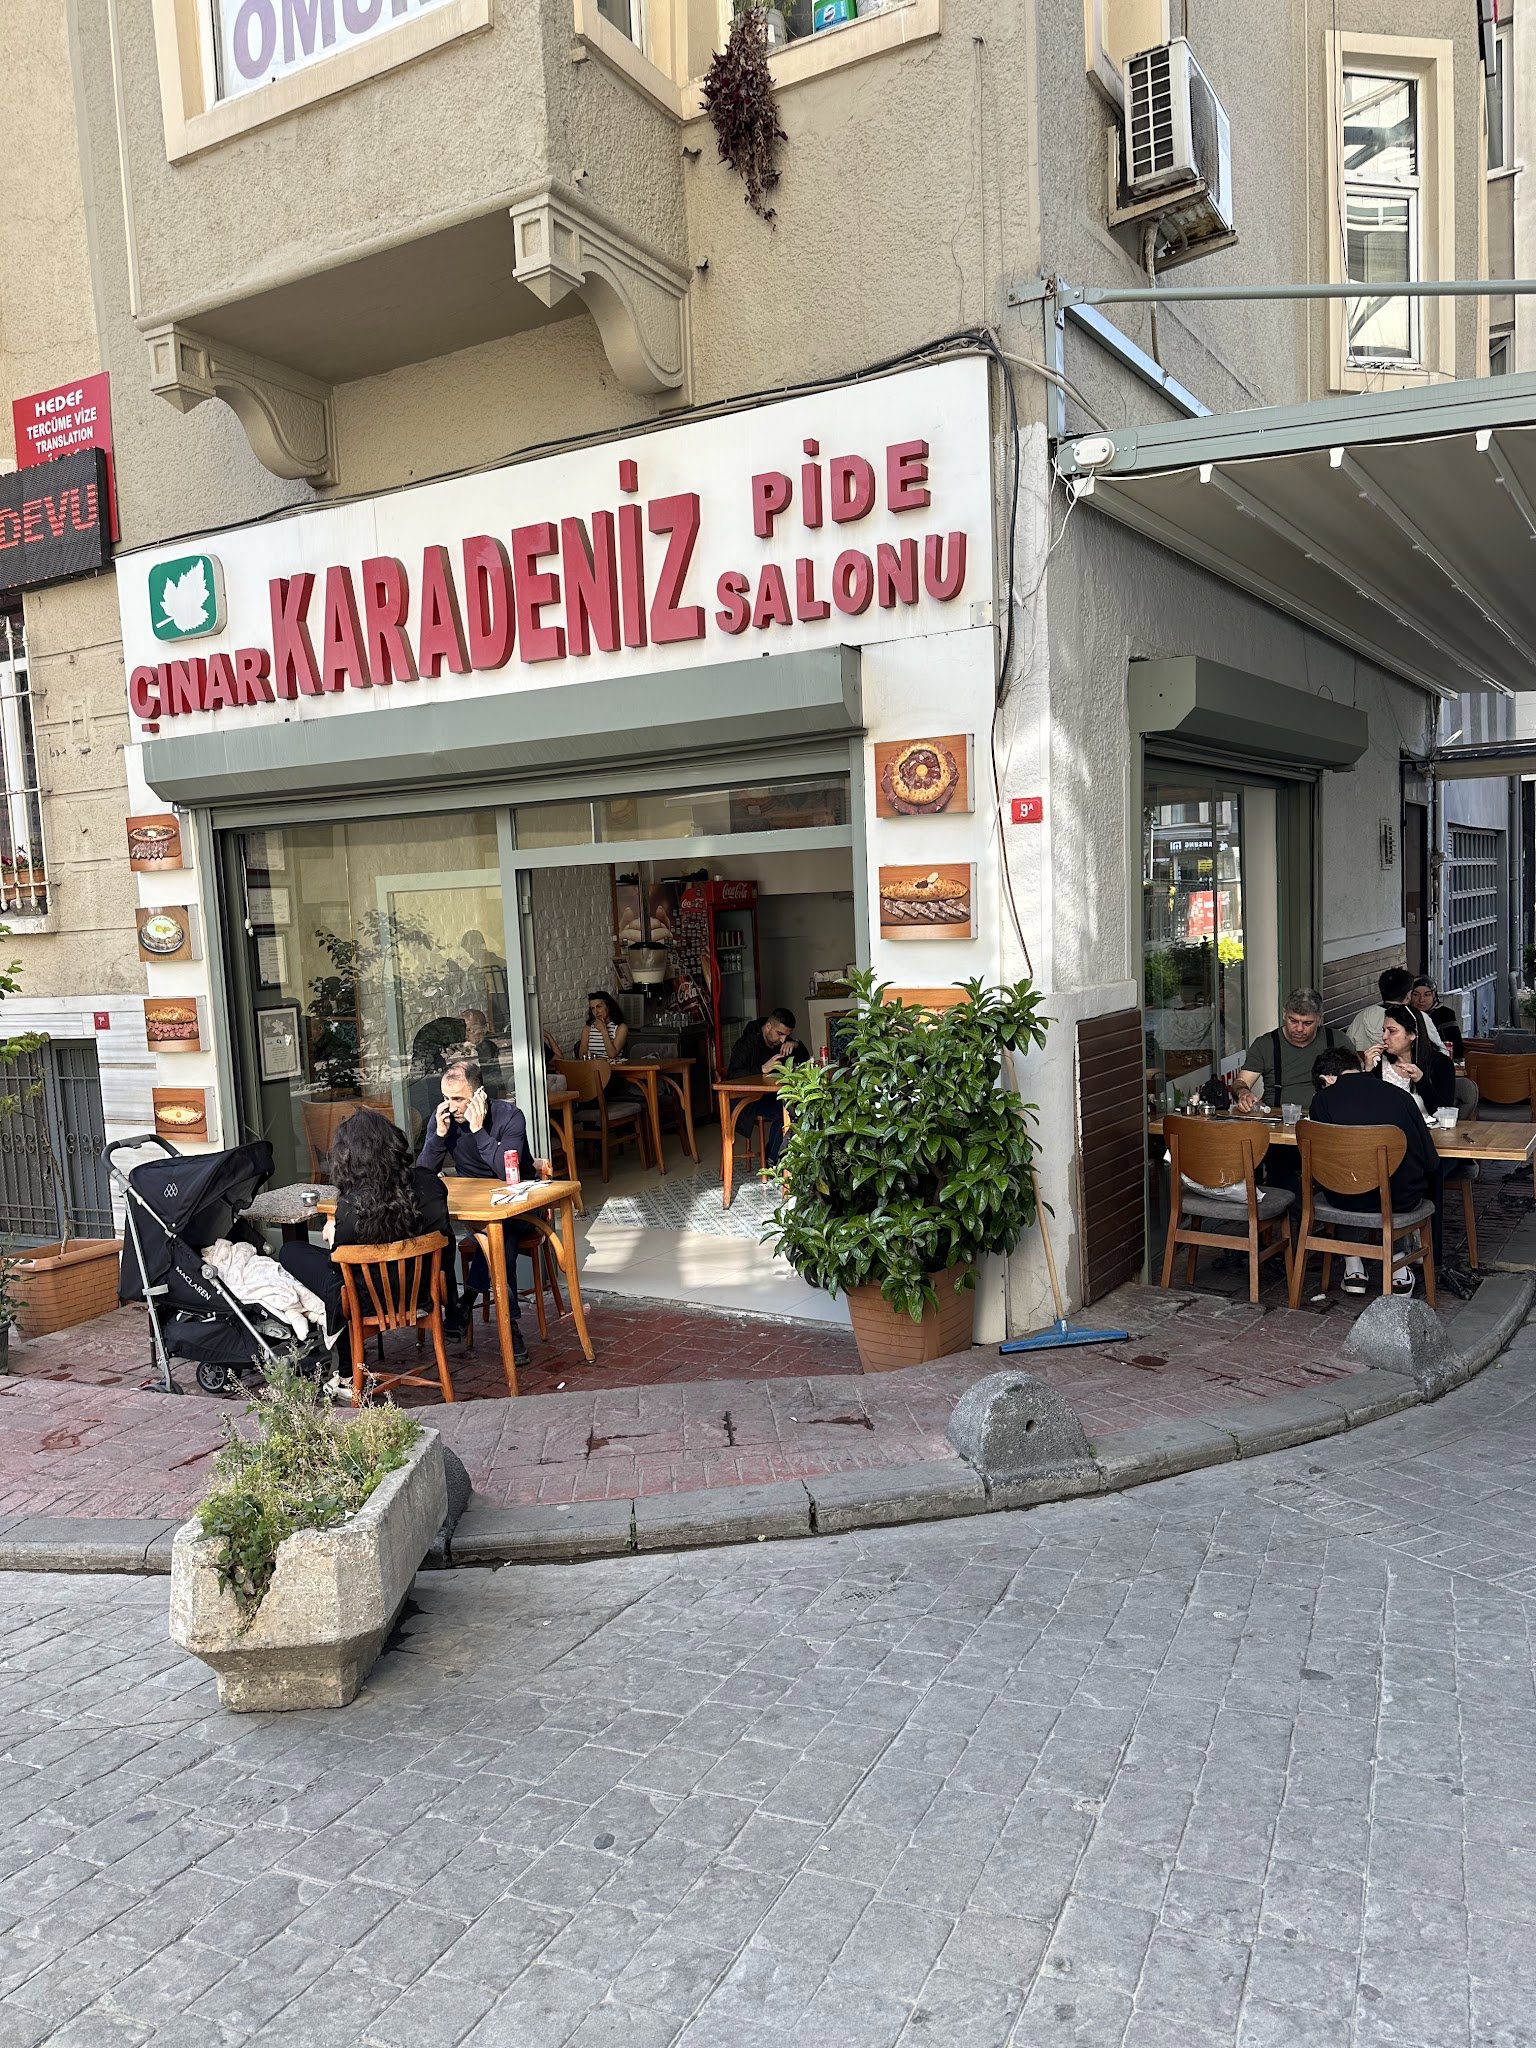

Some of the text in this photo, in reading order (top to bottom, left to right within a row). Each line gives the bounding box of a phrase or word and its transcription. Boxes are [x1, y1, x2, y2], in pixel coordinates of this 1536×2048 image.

[34, 389, 84, 418] HEDEF
[26, 407, 97, 440] TERCÜME VİZE
[35, 425, 94, 454] TRANSLATION
[752, 438, 931, 538] PİDE
[130, 459, 705, 733] ÇINAR KARADENİZ
[716, 531, 967, 635] SALONU
[175, 1266, 212, 1301] MACLAREN
